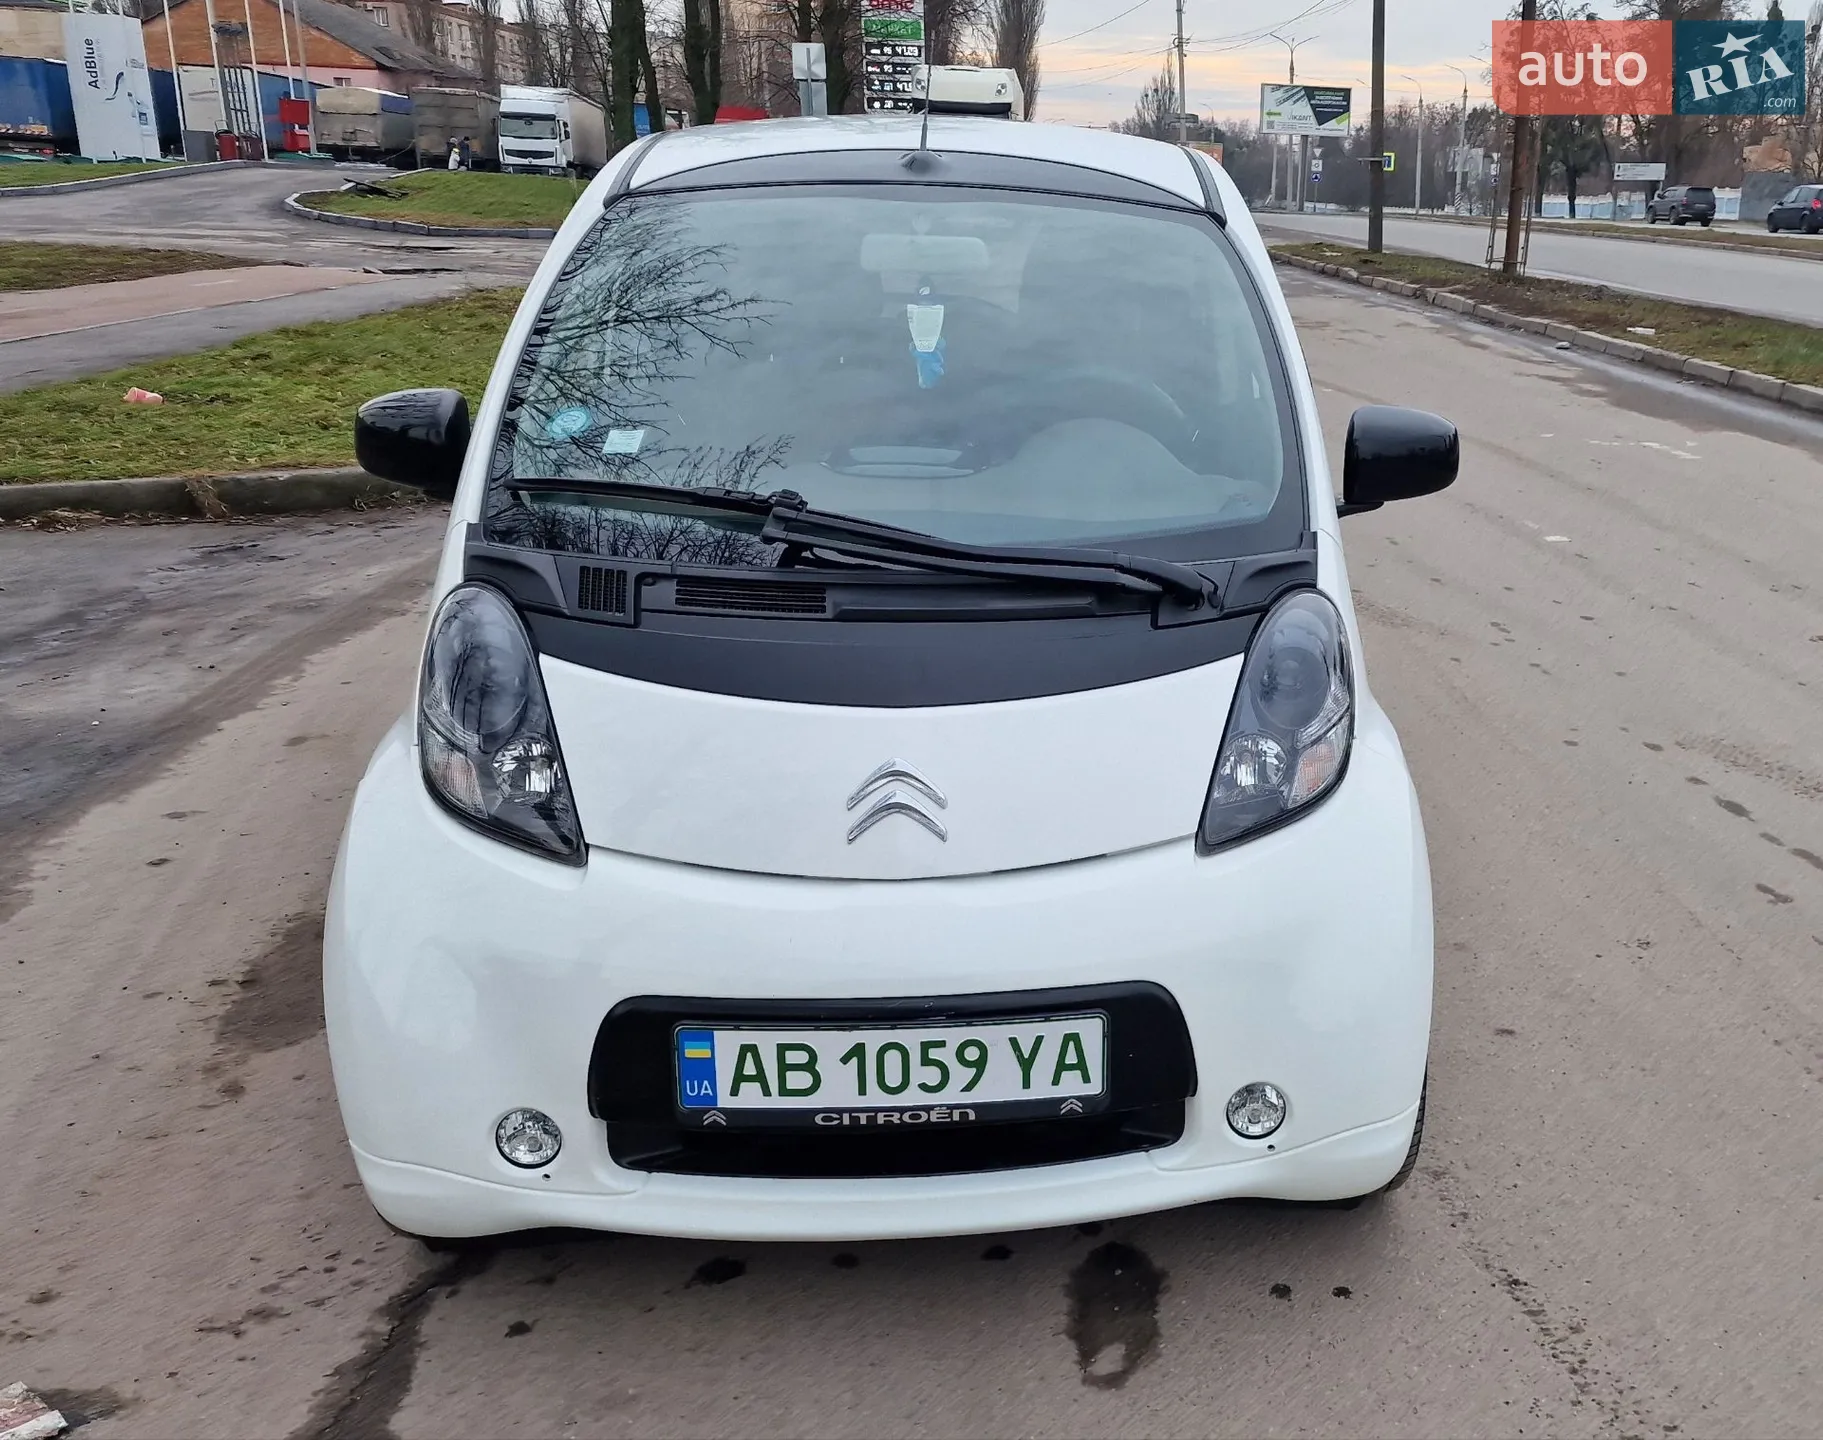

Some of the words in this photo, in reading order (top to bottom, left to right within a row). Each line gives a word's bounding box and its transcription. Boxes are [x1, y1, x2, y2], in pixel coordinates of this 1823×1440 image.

[84, 38, 100, 90] AdBlue
[686, 1080, 713, 1096] UA
[729, 1043, 822, 1097] AB
[839, 1038, 989, 1096] 1059
[1008, 1032, 1092, 1090] YA
